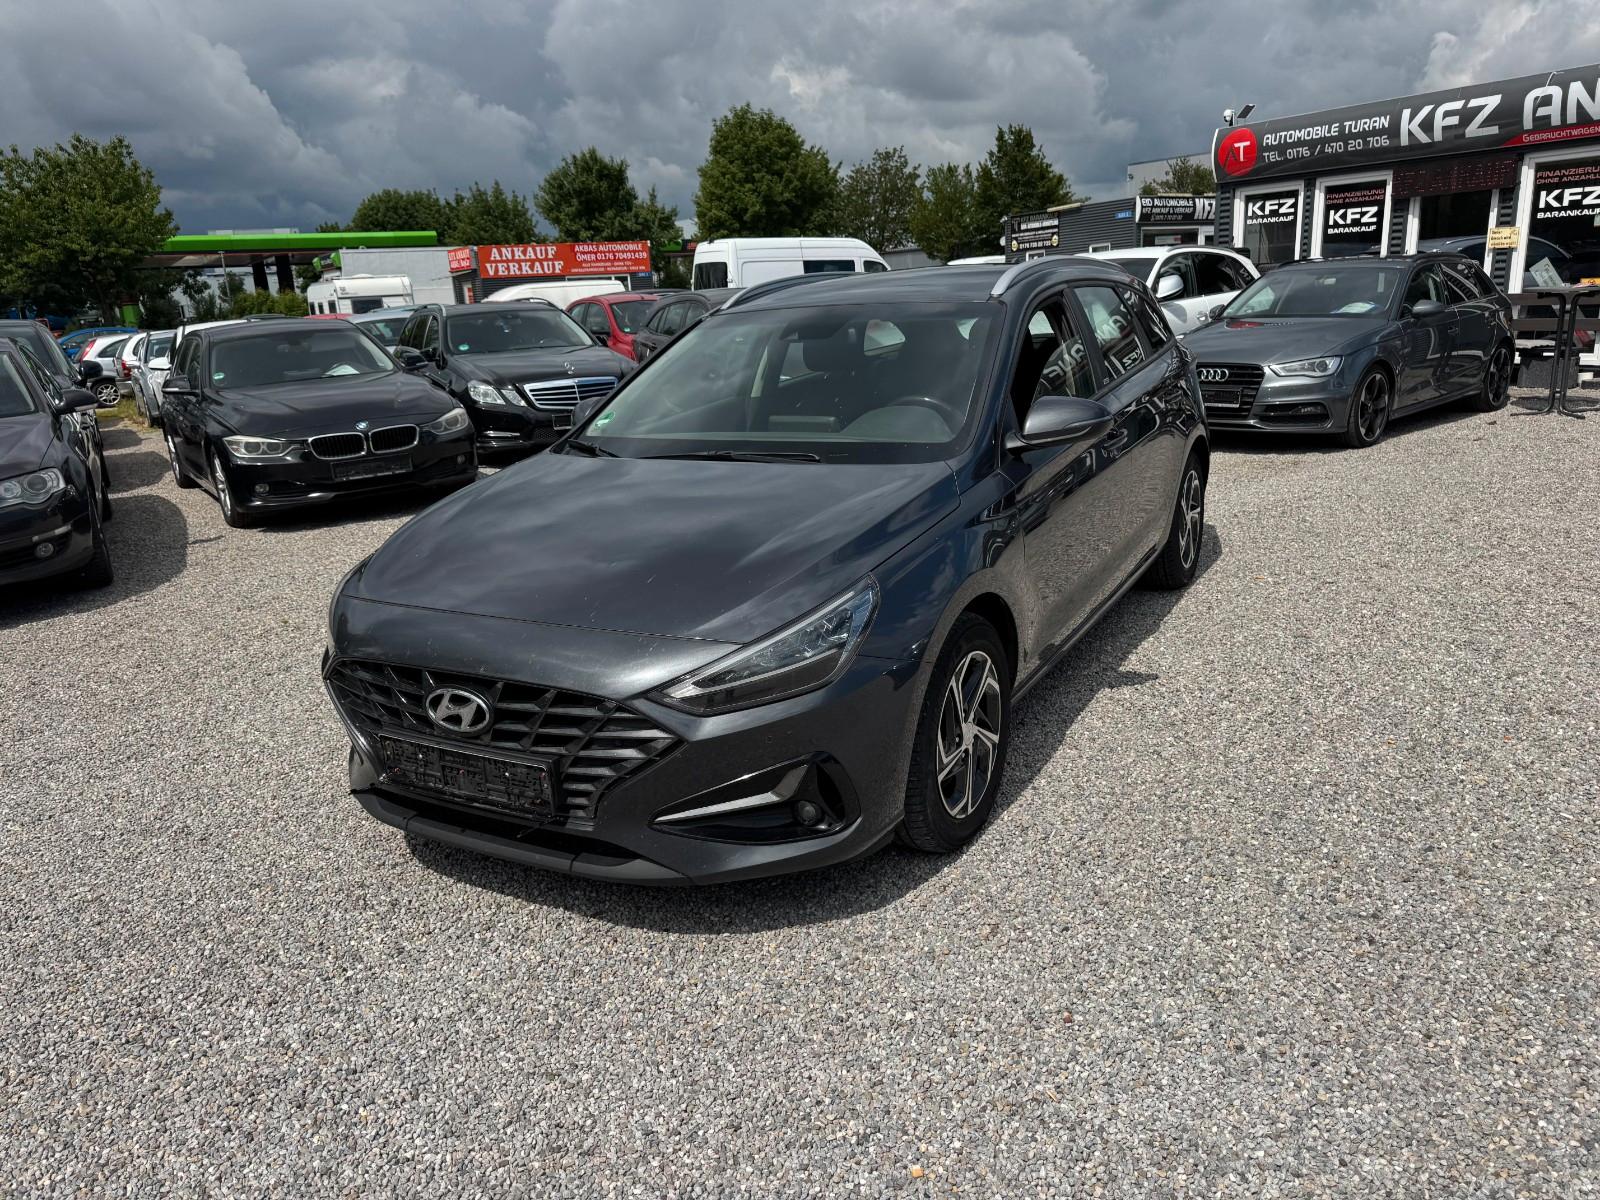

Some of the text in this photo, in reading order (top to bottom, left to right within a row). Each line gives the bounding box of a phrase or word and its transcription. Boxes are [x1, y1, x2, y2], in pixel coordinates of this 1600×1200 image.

[1400, 94, 1502, 146] KFZ
[1263, 115, 1390, 147] AUTOMOBILE TURAN
[1263, 151, 1284, 164] TEL.
[1287, 147, 1311, 160] 0176
[1325, 141, 1343, 154] 470
[1348, 138, 1364, 151] 20
[1369, 135, 1390, 149] 706
[1326, 189, 1385, 199] FINANZIERUNG
[1344, 195, 1385, 203] ANZAHLUNG
[1539, 186, 1600, 208] KFZ
[1154, 198, 1194, 207] AUTOMOBILE
[1247, 198, 1296, 217] KFZ
[1247, 216, 1295, 225] BARANKAUF
[1328, 206, 1379, 226] KFZ
[1327, 225, 1377, 234] BARANKAUF
[490, 246, 557, 261] ANKAUF
[598, 243, 642, 252] AUTOMOBILE
[576, 251, 647, 262] ÖMER 0176 70491439
[485, 260, 564, 276] VERKAUF
